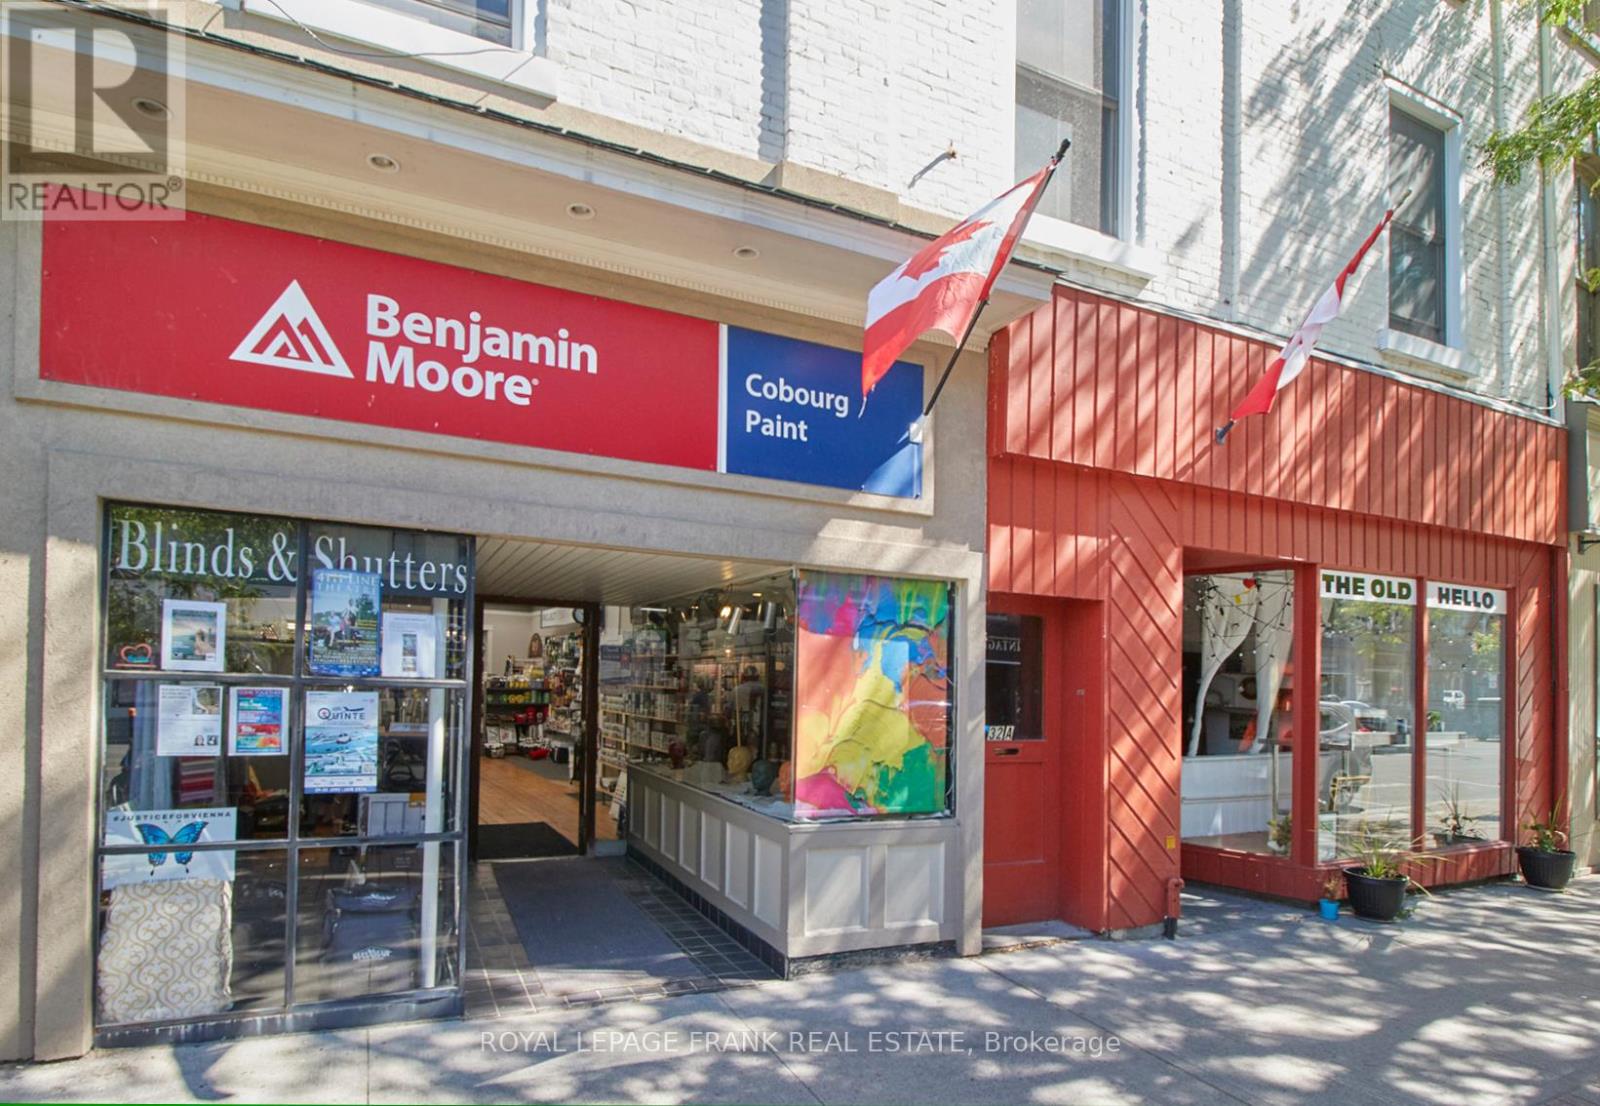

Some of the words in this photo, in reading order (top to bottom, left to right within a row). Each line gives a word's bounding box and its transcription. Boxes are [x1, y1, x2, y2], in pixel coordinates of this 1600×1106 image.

[366, 293, 598, 375] Benjamin
[365, 340, 533, 406] Moore
[745, 373, 849, 418] Cobourg
[745, 409, 808, 442] Paint
[115, 519, 254, 579] Blinds
[267, 531, 298, 582] &
[314, 535, 468, 594] Shutters
[1321, 573, 1365, 597] THE
[1371, 578, 1412, 601] OLD
[1437, 586, 1495, 610] HELLO
[113, 811, 231, 821] #JUSTICEFORVIENNA
